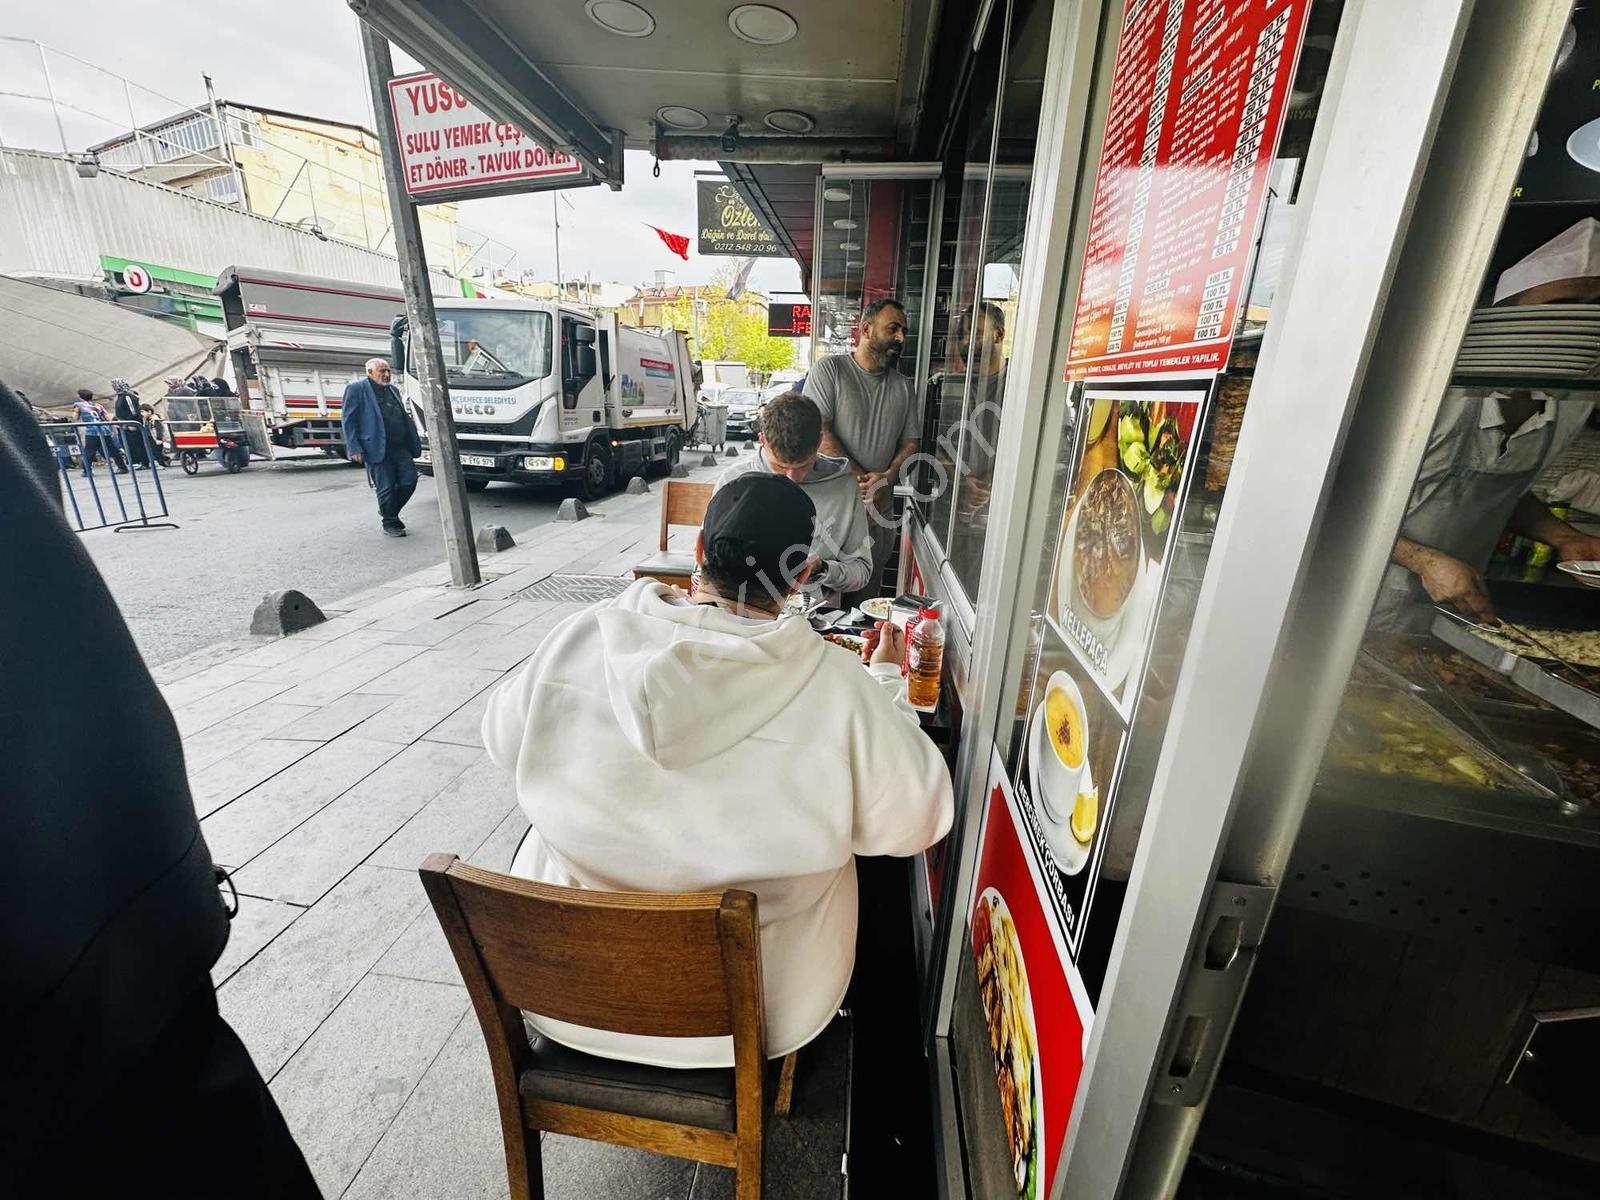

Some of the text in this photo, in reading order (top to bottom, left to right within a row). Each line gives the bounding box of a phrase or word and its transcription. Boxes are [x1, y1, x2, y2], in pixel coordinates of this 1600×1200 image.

[1263, 12, 1285, 37] 70 TL
[1260, 28, 1281, 52] 70 TL
[1257, 44, 1277, 67] 70 TL
[1253, 61, 1274, 84] 60 TL
[1250, 78, 1270, 99] 60 TL
[1246, 93, 1266, 114] 60 TL
[1243, 107, 1263, 128] 50 TL
[407, 121, 526, 155] SULU YEMEK ÇEŞ
[1240, 124, 1260, 143] 40 TL
[1236, 138, 1256, 158] 50 TL
[410, 164, 422, 182] ET
[427, 157, 467, 180] DÖNER
[478, 150, 521, 173] TAVUK
[1234, 153, 1252, 171] 50 TL
[1241, 169, 1249, 180] TL
[1208, 271, 1230, 284] 100 TL
[1205, 285, 1227, 298] 100 TL
[1202, 300, 1223, 312] 100 TL
[1200, 314, 1220, 325] 100 TL
[1196, 328, 1217, 338] 100 TL
[1160, 356, 1190, 366] YEMEKLER
[1192, 352, 1219, 363] YAPILIR.
[1062, 605, 1108, 676] KELLEPAÇA
[1019, 780, 1075, 930] MERCİMEK ÇORBASI
